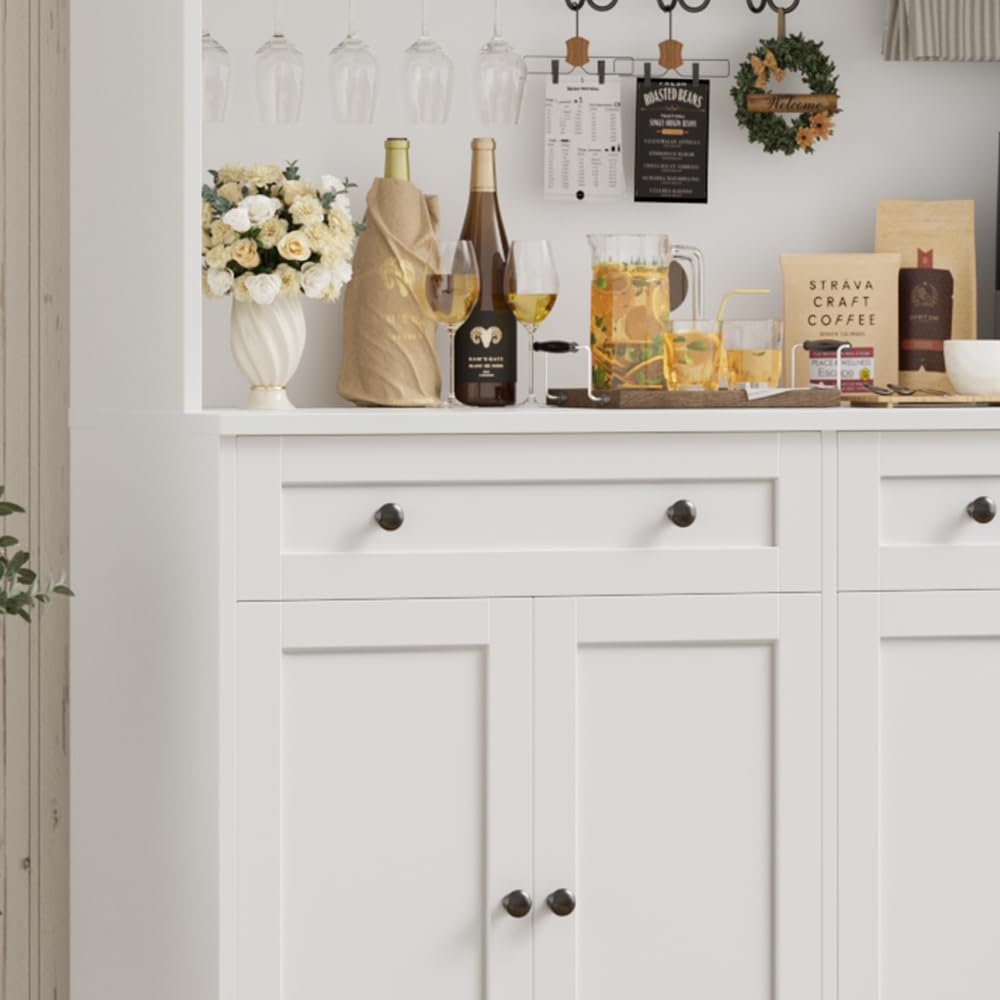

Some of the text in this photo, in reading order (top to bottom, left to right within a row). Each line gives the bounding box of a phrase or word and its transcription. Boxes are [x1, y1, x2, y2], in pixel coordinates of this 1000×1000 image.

[643, 87, 704, 109] ROASTED BEANS
[768, 95, 822, 110] Welcome
[809, 280, 874, 291] STRAVA
[813, 296, 870, 308] CRAFT
[807, 314, 875, 327] COFFEE
